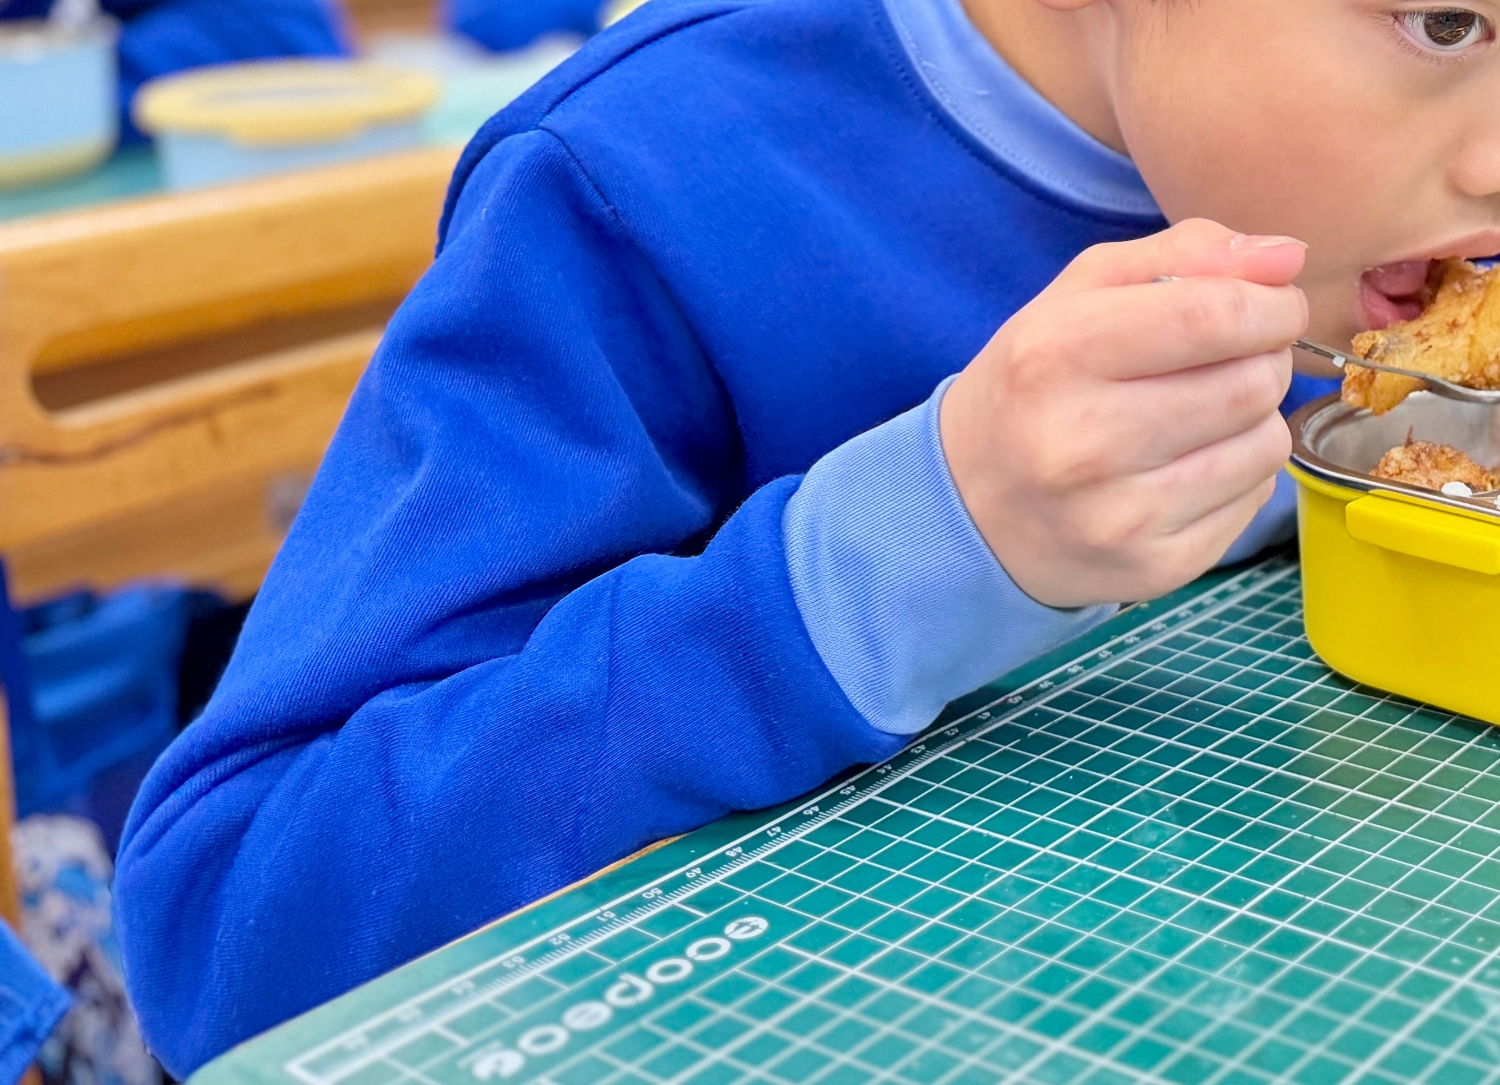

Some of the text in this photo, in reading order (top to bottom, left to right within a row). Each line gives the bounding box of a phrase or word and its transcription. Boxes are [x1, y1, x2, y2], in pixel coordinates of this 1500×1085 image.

[944, 727, 959, 736] 42
[911, 744, 926, 754] 43
[877, 764, 892, 774] 44
[840, 785, 856, 795] 45
[803, 805, 819, 816] 46
[766, 826, 782, 837] 47
[725, 846, 743, 857] 48
[686, 868, 702, 879] 49
[642, 887, 663, 899] 50
[596, 910, 616, 923] 51
[549, 933, 571, 946] 52
[503, 955, 526, 969] 53
